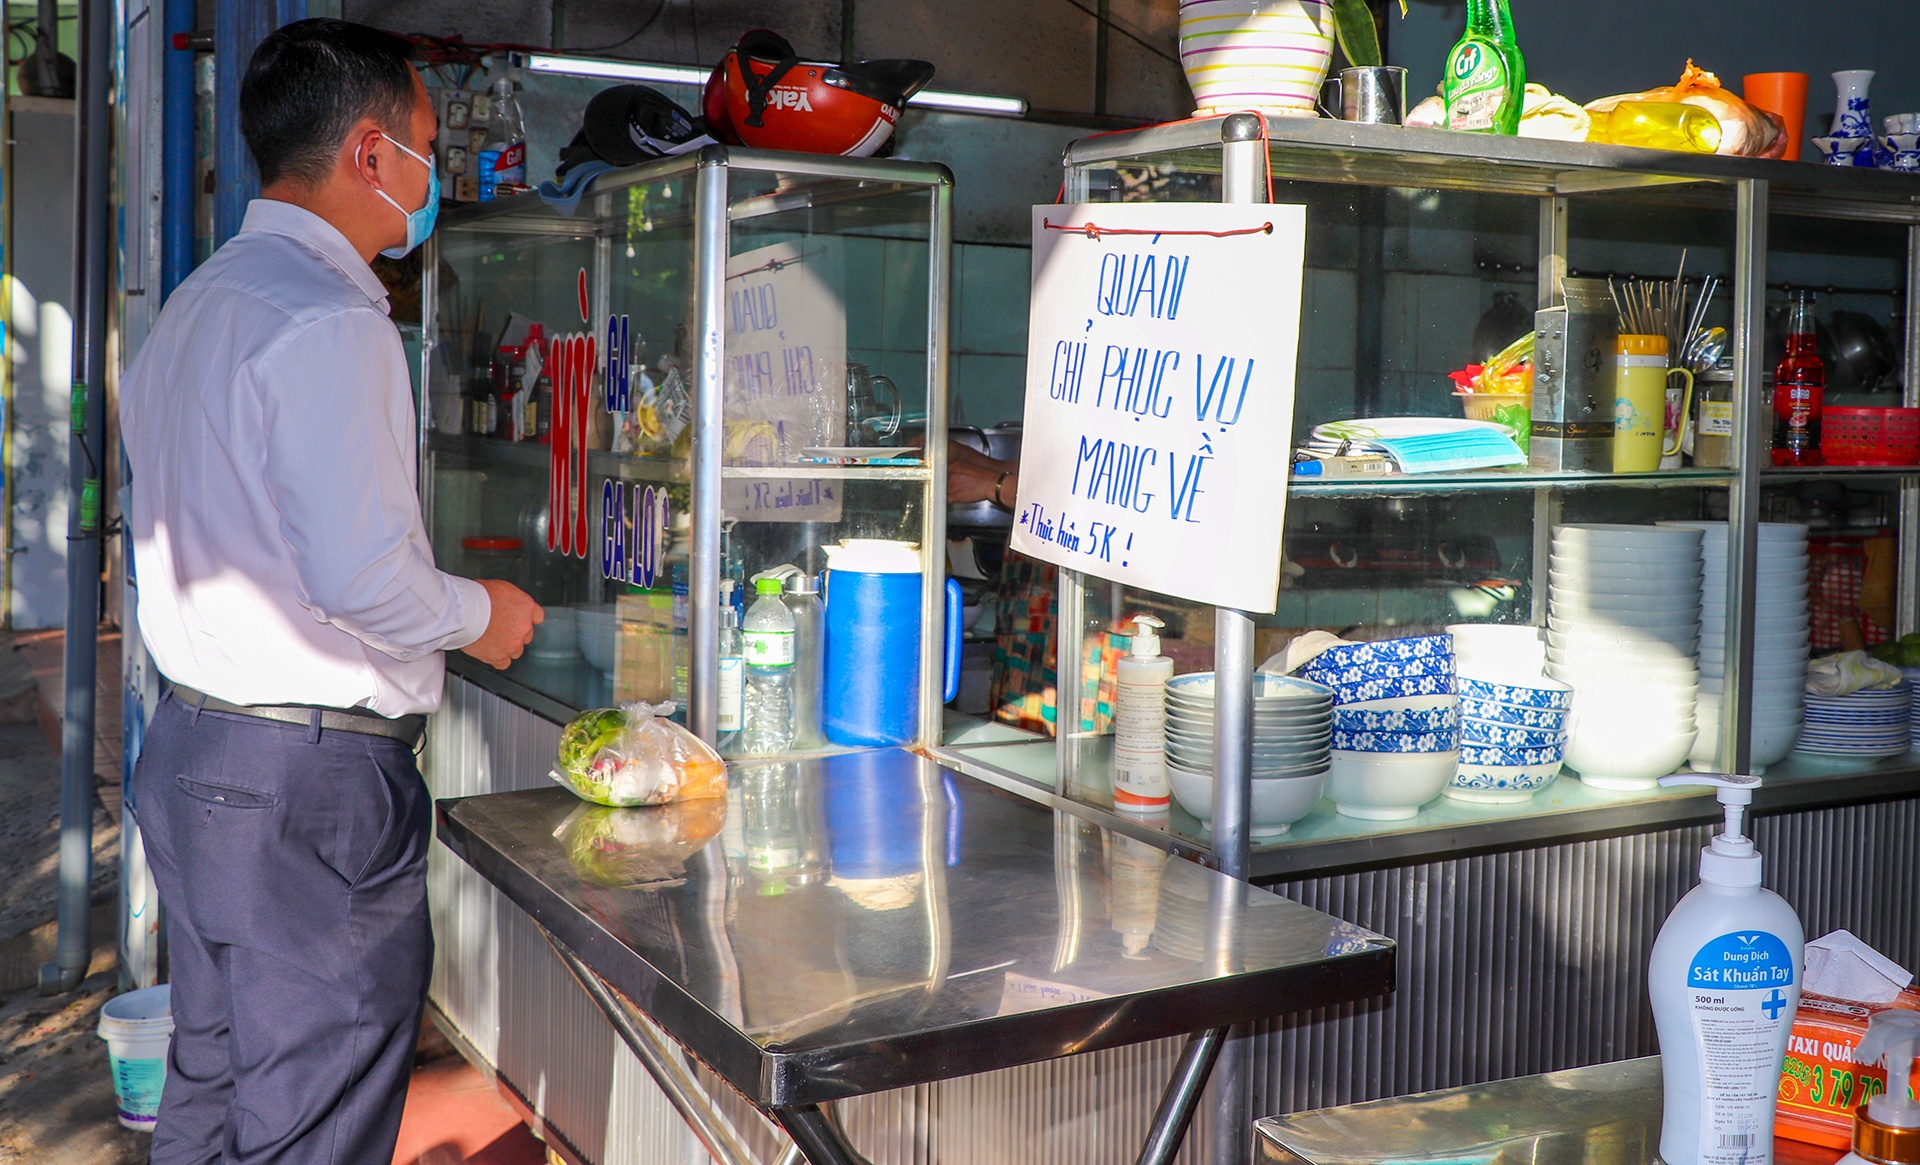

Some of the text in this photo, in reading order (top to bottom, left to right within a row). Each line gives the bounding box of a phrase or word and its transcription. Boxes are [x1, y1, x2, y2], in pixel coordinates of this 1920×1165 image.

[1455, 47, 1477, 76] Cif
[745, 90, 813, 112] Yak
[1097, 233, 1190, 320] QUÁN
[1049, 318, 1255, 434] CHỈ PHỤC VỤ
[1071, 432, 1215, 524] MANG VỀ
[1723, 950, 1769, 964] Dung Dịch
[1693, 965, 1790, 983] Sát Khuẩn Tay
[1695, 995, 1711, 1004] 500
[1787, 1034, 1819, 1057] TAXI
[1822, 1039, 1872, 1067] QUẢ
[1828, 1067, 1854, 1110] 79
